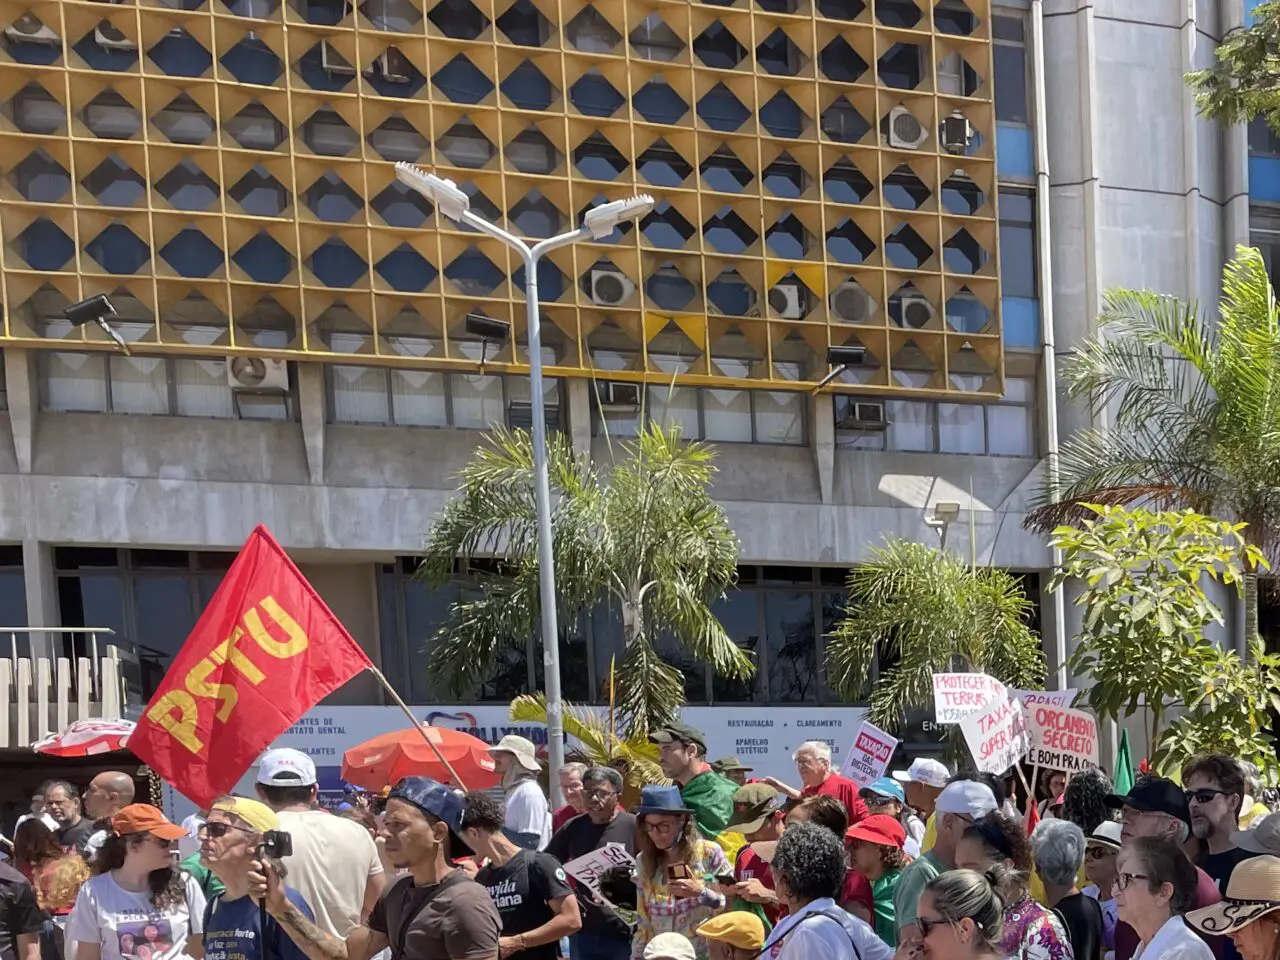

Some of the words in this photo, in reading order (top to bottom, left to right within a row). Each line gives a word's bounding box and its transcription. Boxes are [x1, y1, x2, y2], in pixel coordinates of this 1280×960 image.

[147, 596, 308, 754] PSTU
[318, 726, 347, 735] DENTAL
[796, 720, 842, 728] CLAREAMENTO
[1043, 729, 1092, 755] SECRETO
[1038, 749, 1060, 766] BOM
[1063, 754, 1080, 770] PRA
[234, 928, 256, 938] forte
